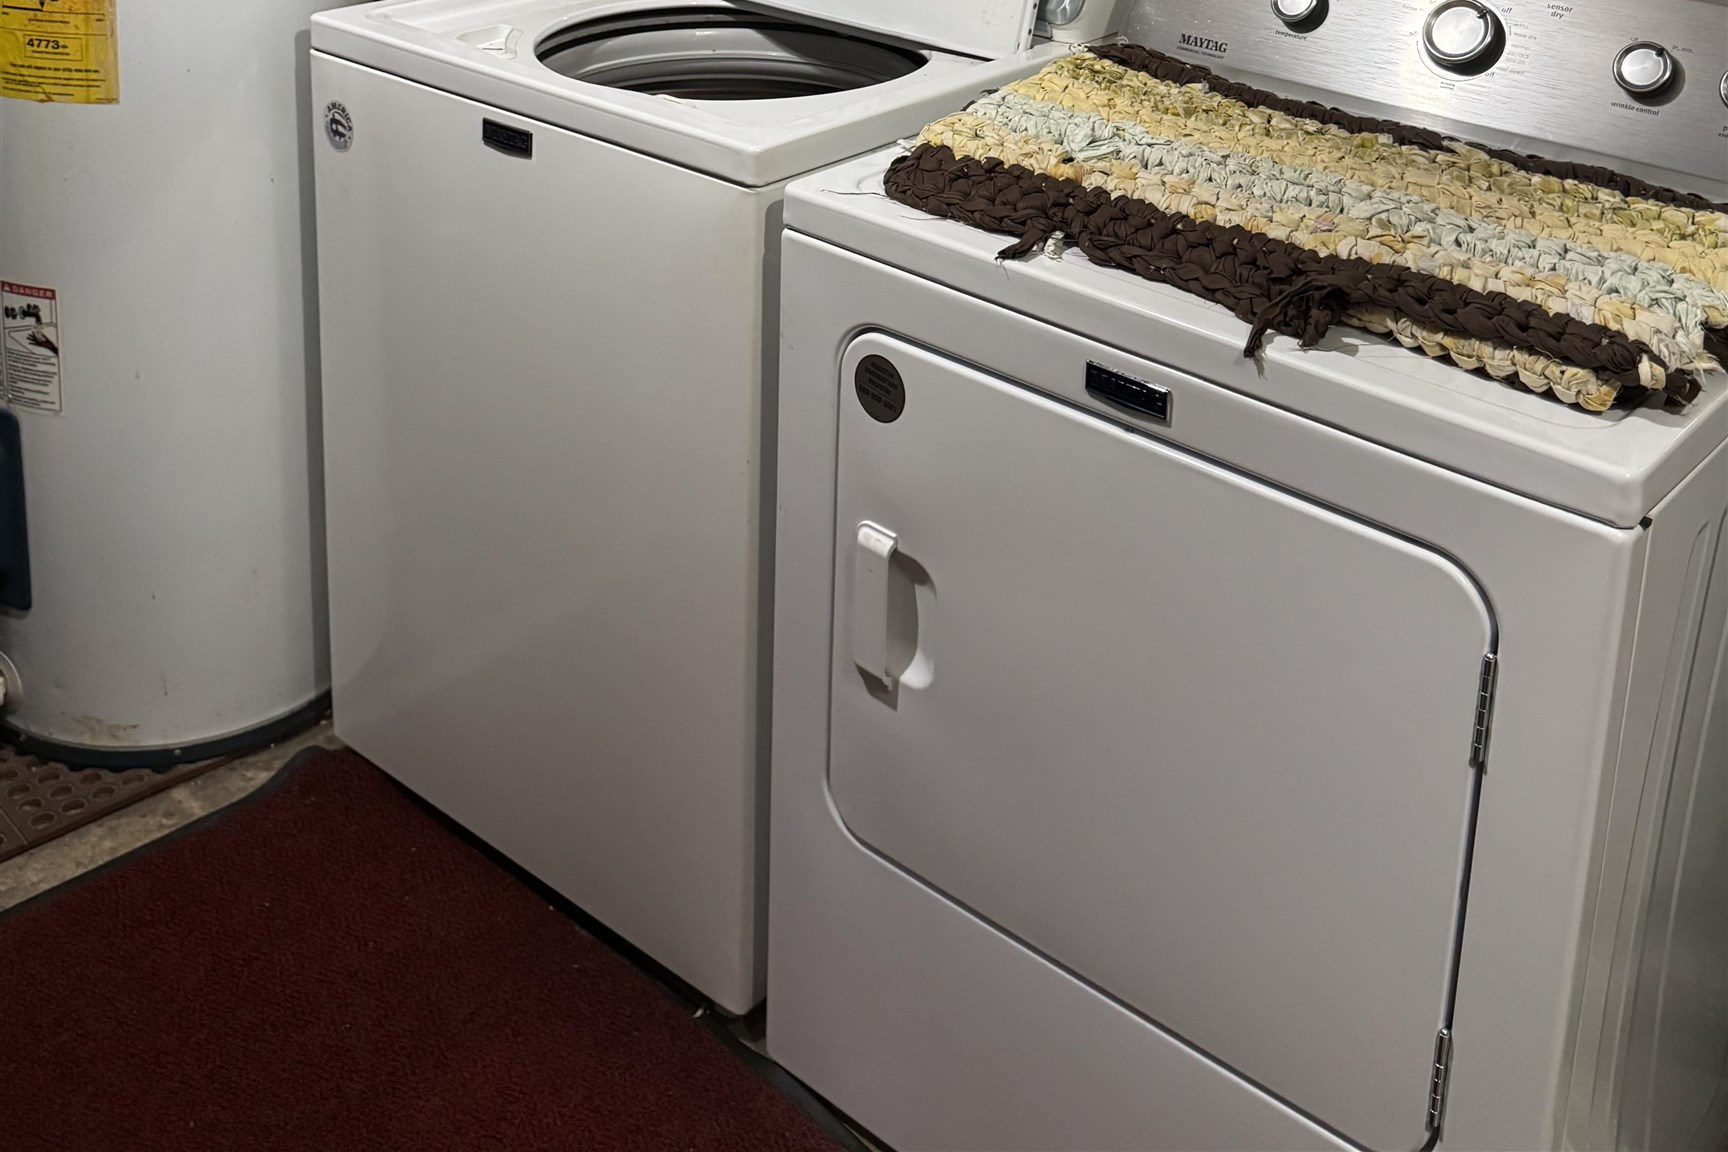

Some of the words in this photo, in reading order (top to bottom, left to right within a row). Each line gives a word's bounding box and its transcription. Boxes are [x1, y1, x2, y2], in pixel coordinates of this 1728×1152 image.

[1547, 4, 1573, 12] sensor
[1551, 11, 1564, 19] dry
[1275, 29, 1308, 41] temperature
[27, 38, 60, 49] 4773
[1178, 34, 1228, 53] MAYTAG
[1610, 101, 1635, 111] wrinkle
[1636, 106, 1660, 116] control
[13, 287, 53, 298] DANGER
